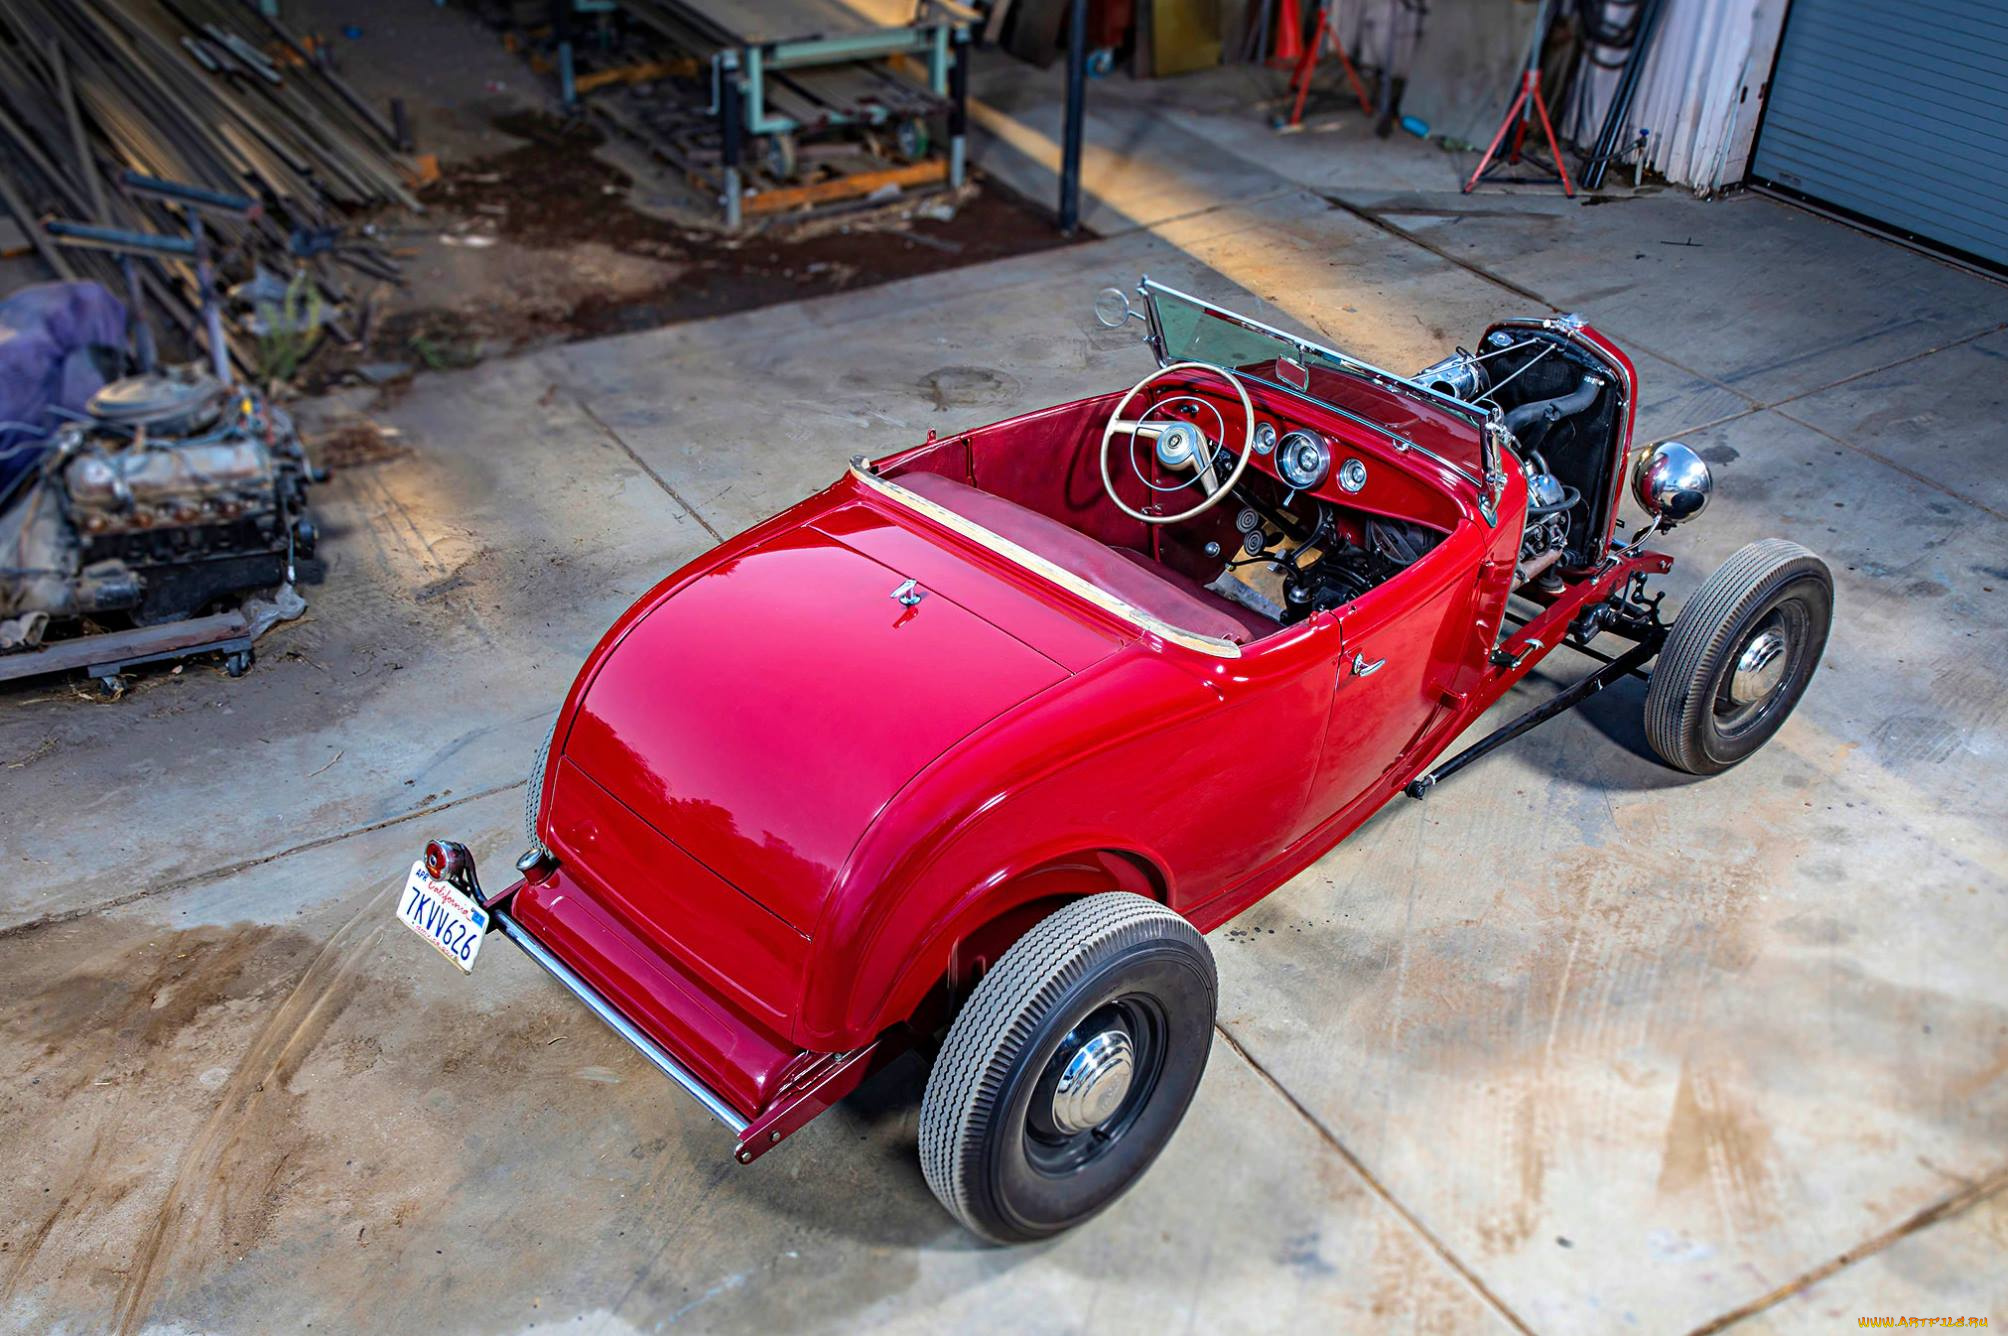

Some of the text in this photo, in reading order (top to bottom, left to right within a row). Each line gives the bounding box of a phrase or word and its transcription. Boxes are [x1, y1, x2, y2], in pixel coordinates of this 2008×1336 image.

[416, 868, 429, 882] APR
[428, 881, 470, 919] California
[406, 886, 477, 961] 7KVV626
